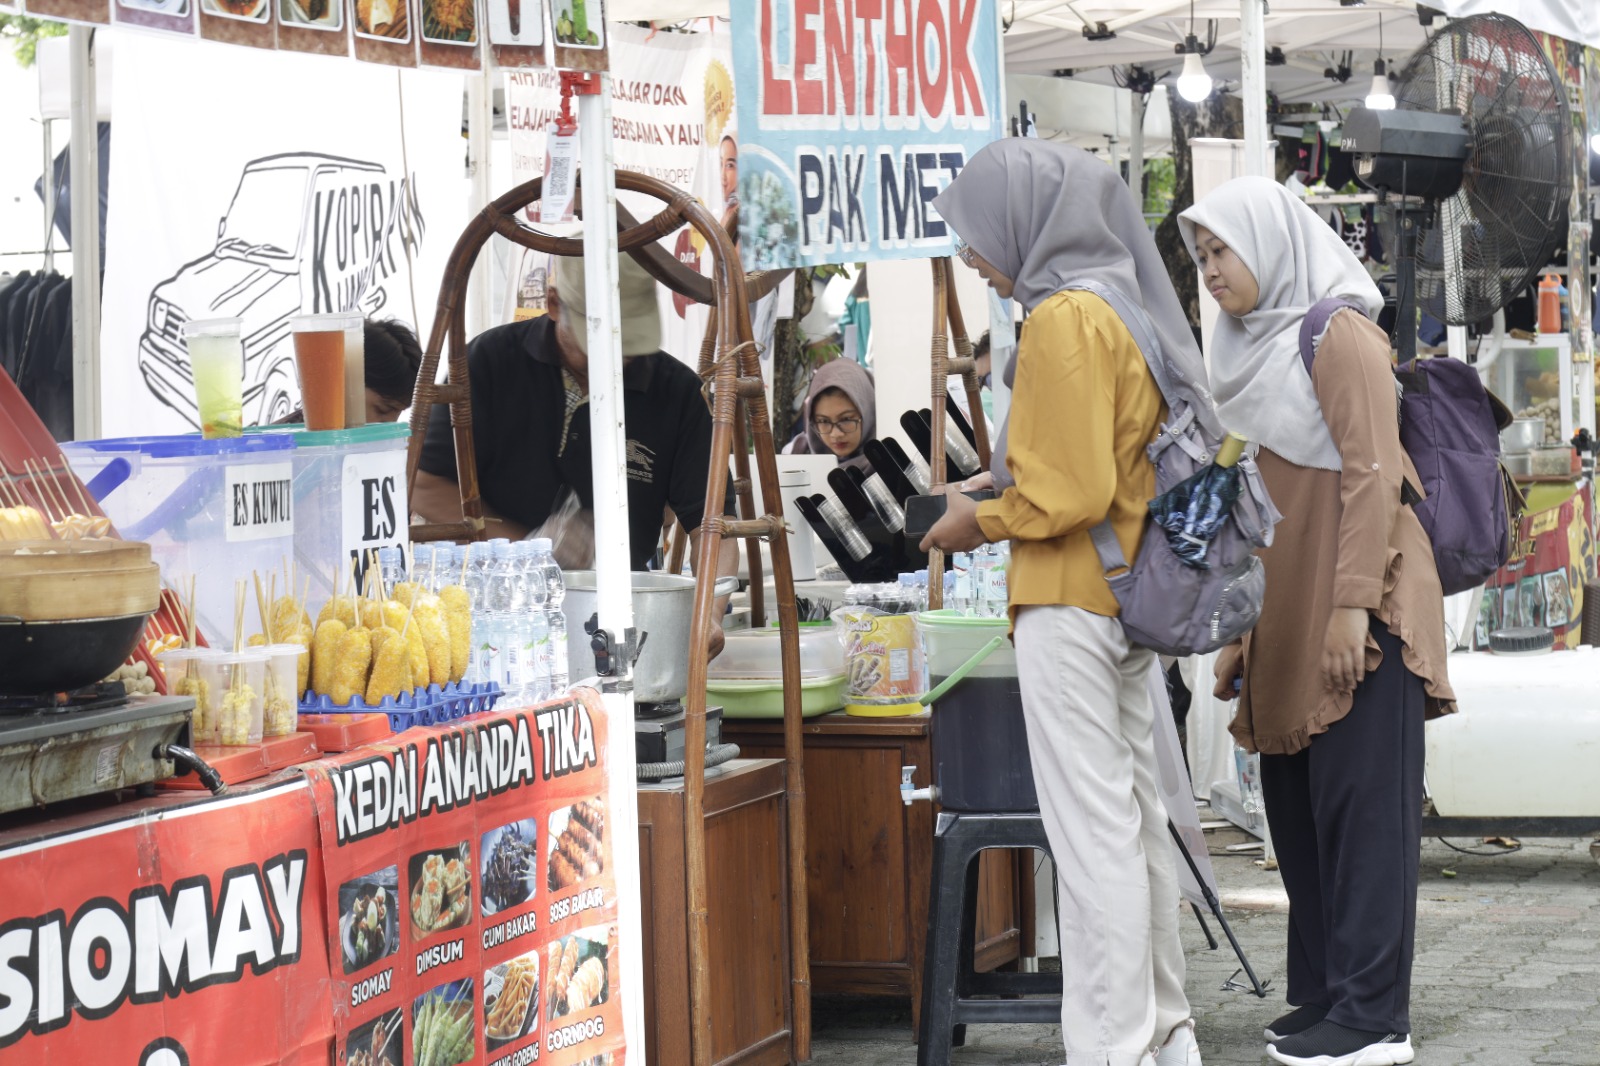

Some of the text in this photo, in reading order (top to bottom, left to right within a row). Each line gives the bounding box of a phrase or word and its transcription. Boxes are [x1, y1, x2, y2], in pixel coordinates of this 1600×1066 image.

[760, 0, 985, 118] LENTHOK
[652, 83, 687, 106] DAN
[612, 116, 664, 146] BERSAMA
[799, 154, 867, 246] PAK
[232, 479, 292, 527] ES KUWUT
[361, 476, 397, 542] ES
[331, 702, 597, 843] KEDAI ANANDA TIKA
[0, 856, 306, 1040] SIOMAY
[482, 912, 538, 950] CUMI BAKAR
[415, 939, 464, 976] DIMSUM
[350, 967, 394, 1007] SIOMAY
[512, 1041, 539, 1066] GORENG
[546, 1016, 605, 1053] CORNDOG
